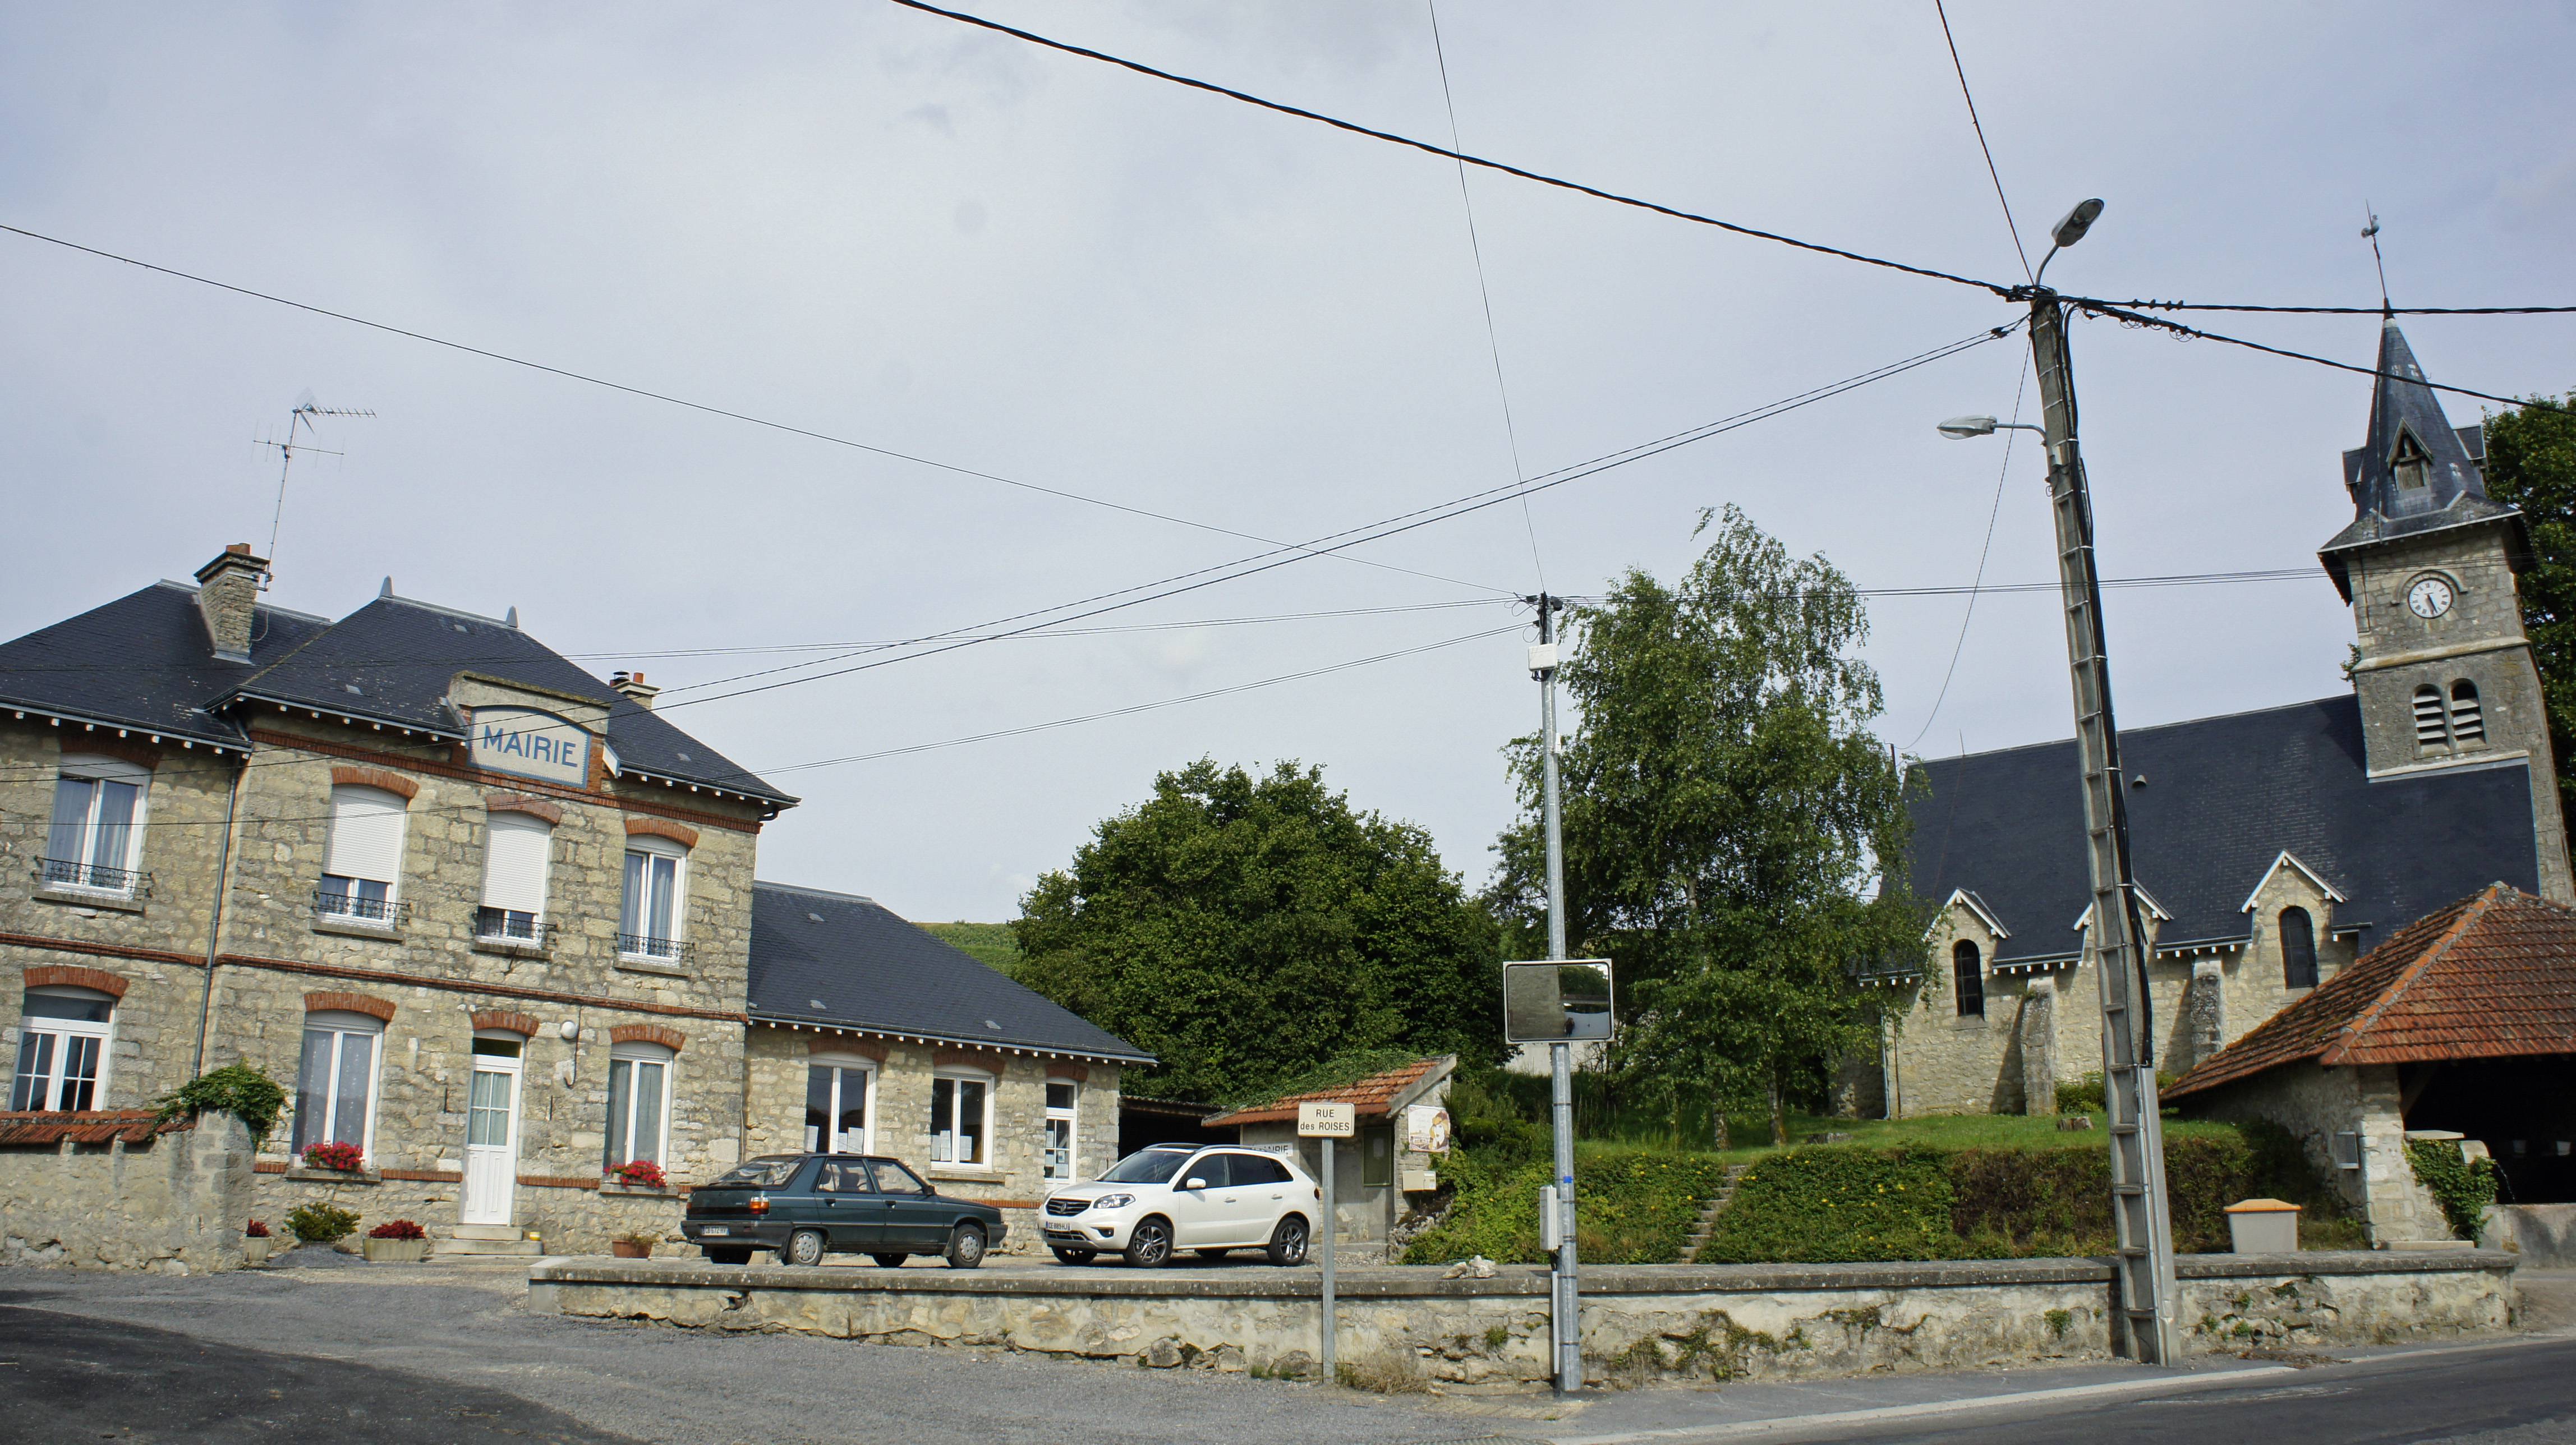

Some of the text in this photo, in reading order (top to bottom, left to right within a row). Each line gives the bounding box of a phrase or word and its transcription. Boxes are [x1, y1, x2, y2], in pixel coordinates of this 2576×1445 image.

[483, 724, 578, 768] MAIRIE
[1315, 1108, 1335, 1118] RUE
[1300, 1121, 1350, 1131] des ROISES
